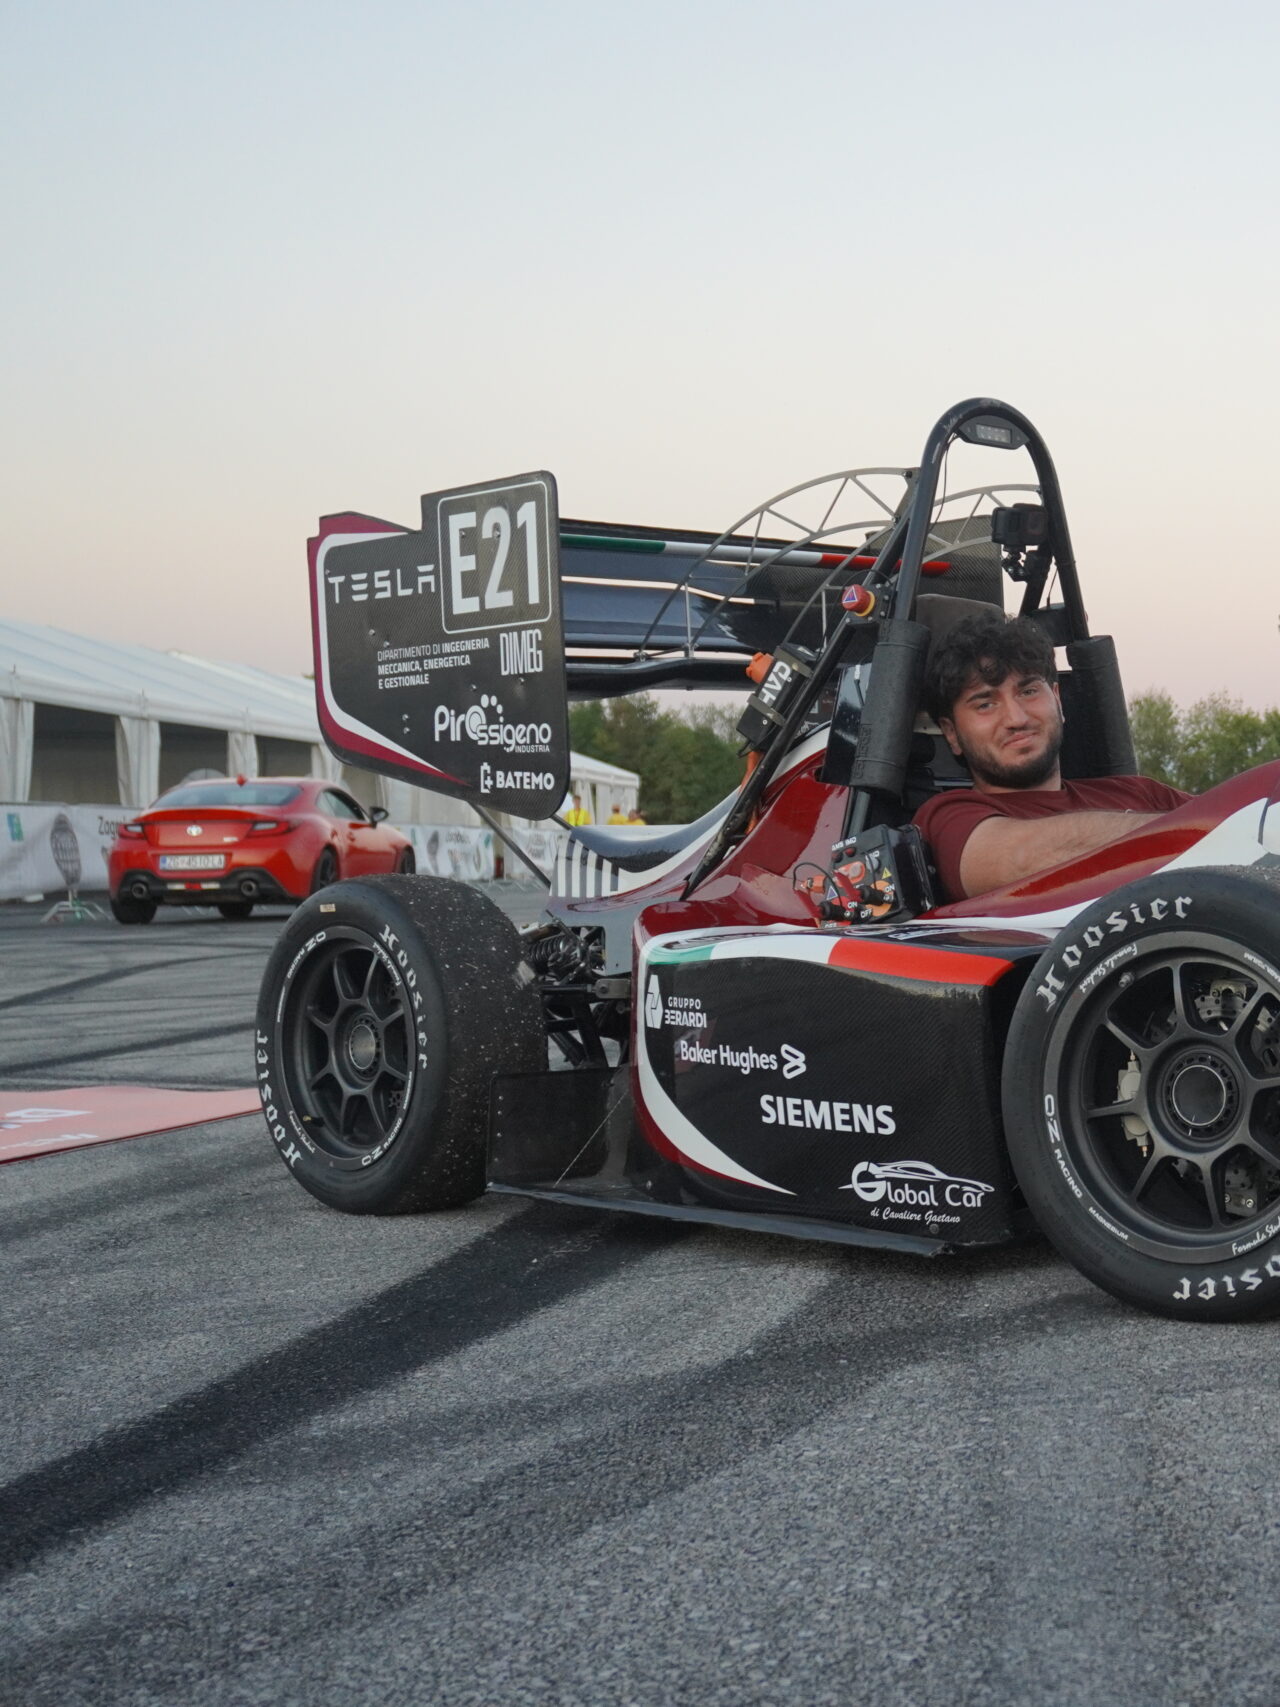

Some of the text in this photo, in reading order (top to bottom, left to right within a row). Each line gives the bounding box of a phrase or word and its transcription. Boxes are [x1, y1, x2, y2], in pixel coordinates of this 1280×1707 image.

[449, 501, 541, 615] E21
[328, 564, 436, 604] TESLA
[377, 638, 490, 662] DIPARTIMENTO DI INGEGNERIA
[499, 629, 543, 676] DIMEG
[378, 655, 471, 676] MECCANICA, ENERGETICA
[378, 674, 430, 690] E GESTIONALE
[761, 660, 791, 704] HVD
[514, 745, 550, 754] INDUSTRIA
[495, 770, 555, 791] BATEMO
[847, 901, 858, 909] ON
[860, 908, 873, 918] OFF
[1034, 896, 1193, 1012] Hoosier
[379, 924, 428, 1070] Hoosier
[668, 996, 701, 1010] GRUPPO
[664, 1009, 707, 1028] BERARDI
[680, 1039, 778, 1075] Baker Hughes
[256, 1029, 303, 1168] Hoosier
[760, 1094, 897, 1136] SIEMENS
[851, 1161, 985, 1208] Global Car
[1054, 1148, 1083, 1199] RACING
[870, 1207, 961, 1225] di Cavaliere Gaetano
[1231, 1231, 1267, 1256] Formula
